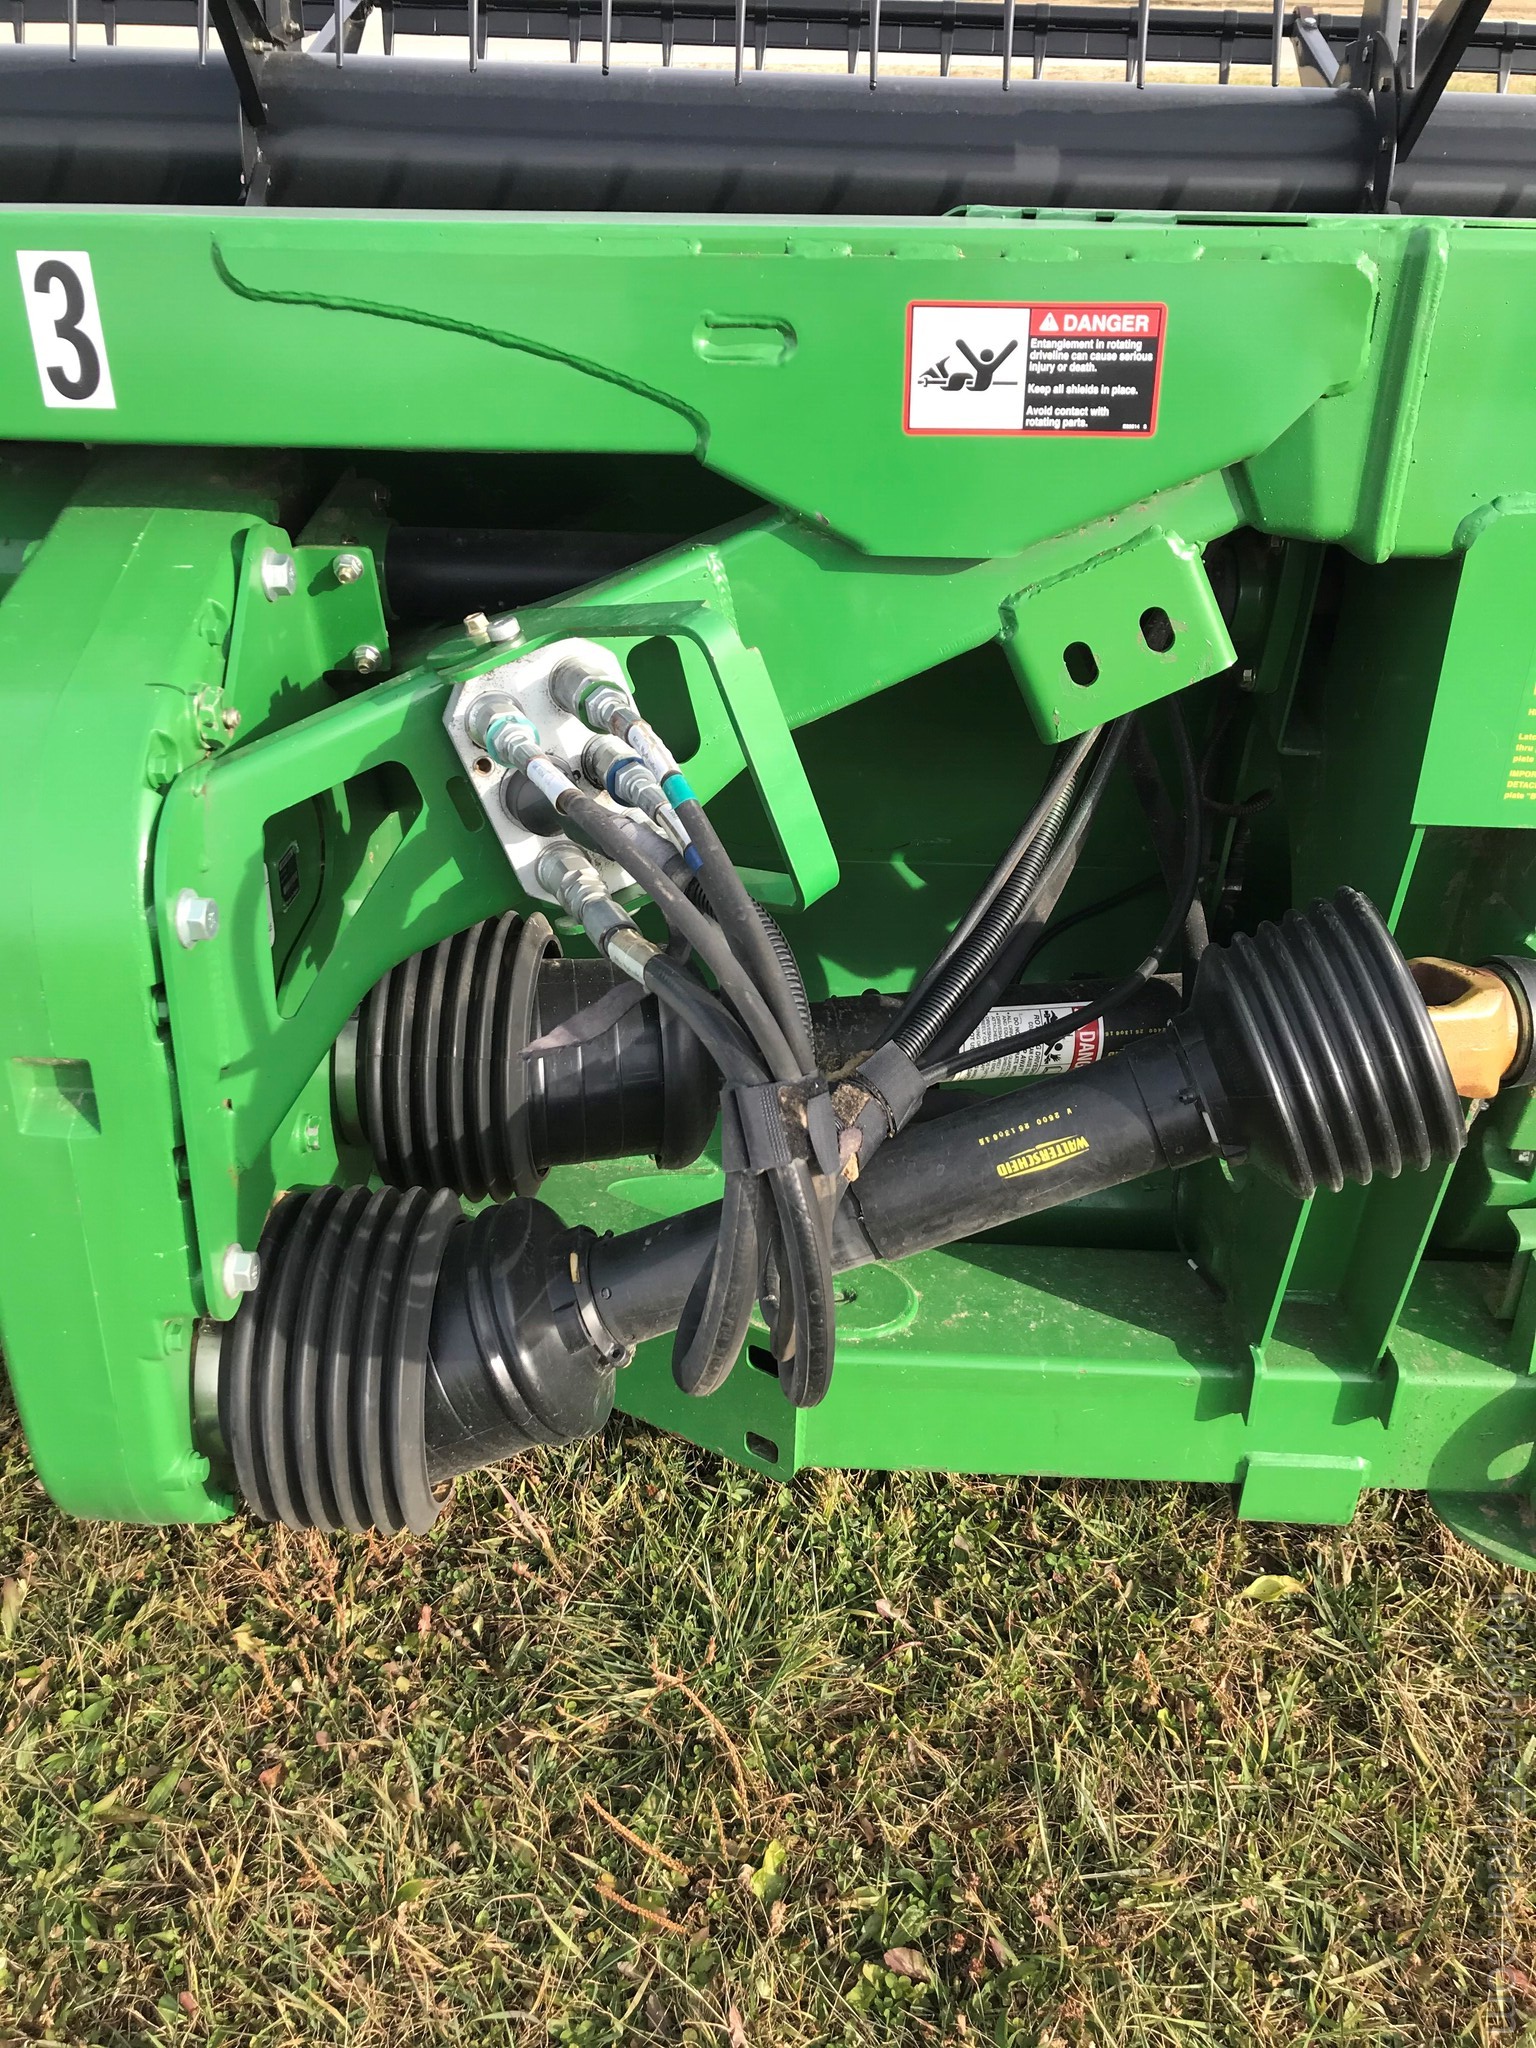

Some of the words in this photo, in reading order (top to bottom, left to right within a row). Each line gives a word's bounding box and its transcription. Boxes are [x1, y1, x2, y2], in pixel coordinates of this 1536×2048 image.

[1063, 314, 1150, 332] DANGER
[34, 259, 101, 401] 3
[1030, 338, 1094, 351] Entanglement
[1095, 339, 1105, 350] in
[1106, 339, 1143, 352] rotating
[1029, 350, 1070, 361] driveline
[1071, 352, 1088, 361] can
[1090, 352, 1118, 361] cause
[1119, 351, 1153, 362] serious
[1029, 361, 1056, 374] injury
[1056, 363, 1068, 372] or
[1069, 362, 1097, 372] death.
[1027, 383, 1051, 396] Keep
[1053, 384, 1064, 394] all
[1065, 384, 1099, 395] shields
[1100, 384, 1110, 394] in
[1111, 385, 1138, 397] place.
[1026, 405, 1053, 416] Avoid
[1054, 406, 1088, 416] contact
[1090, 406, 1110, 416] with
[1025, 417, 1061, 429] rotating
[1062, 418, 1088, 429] parts.
[1516, 744, 1534, 752] thru
[1512, 755, 1535, 763] plate
[1504, 791, 1525, 800] plate
[996, 1135, 1090, 1177] WALTERSCHEID
